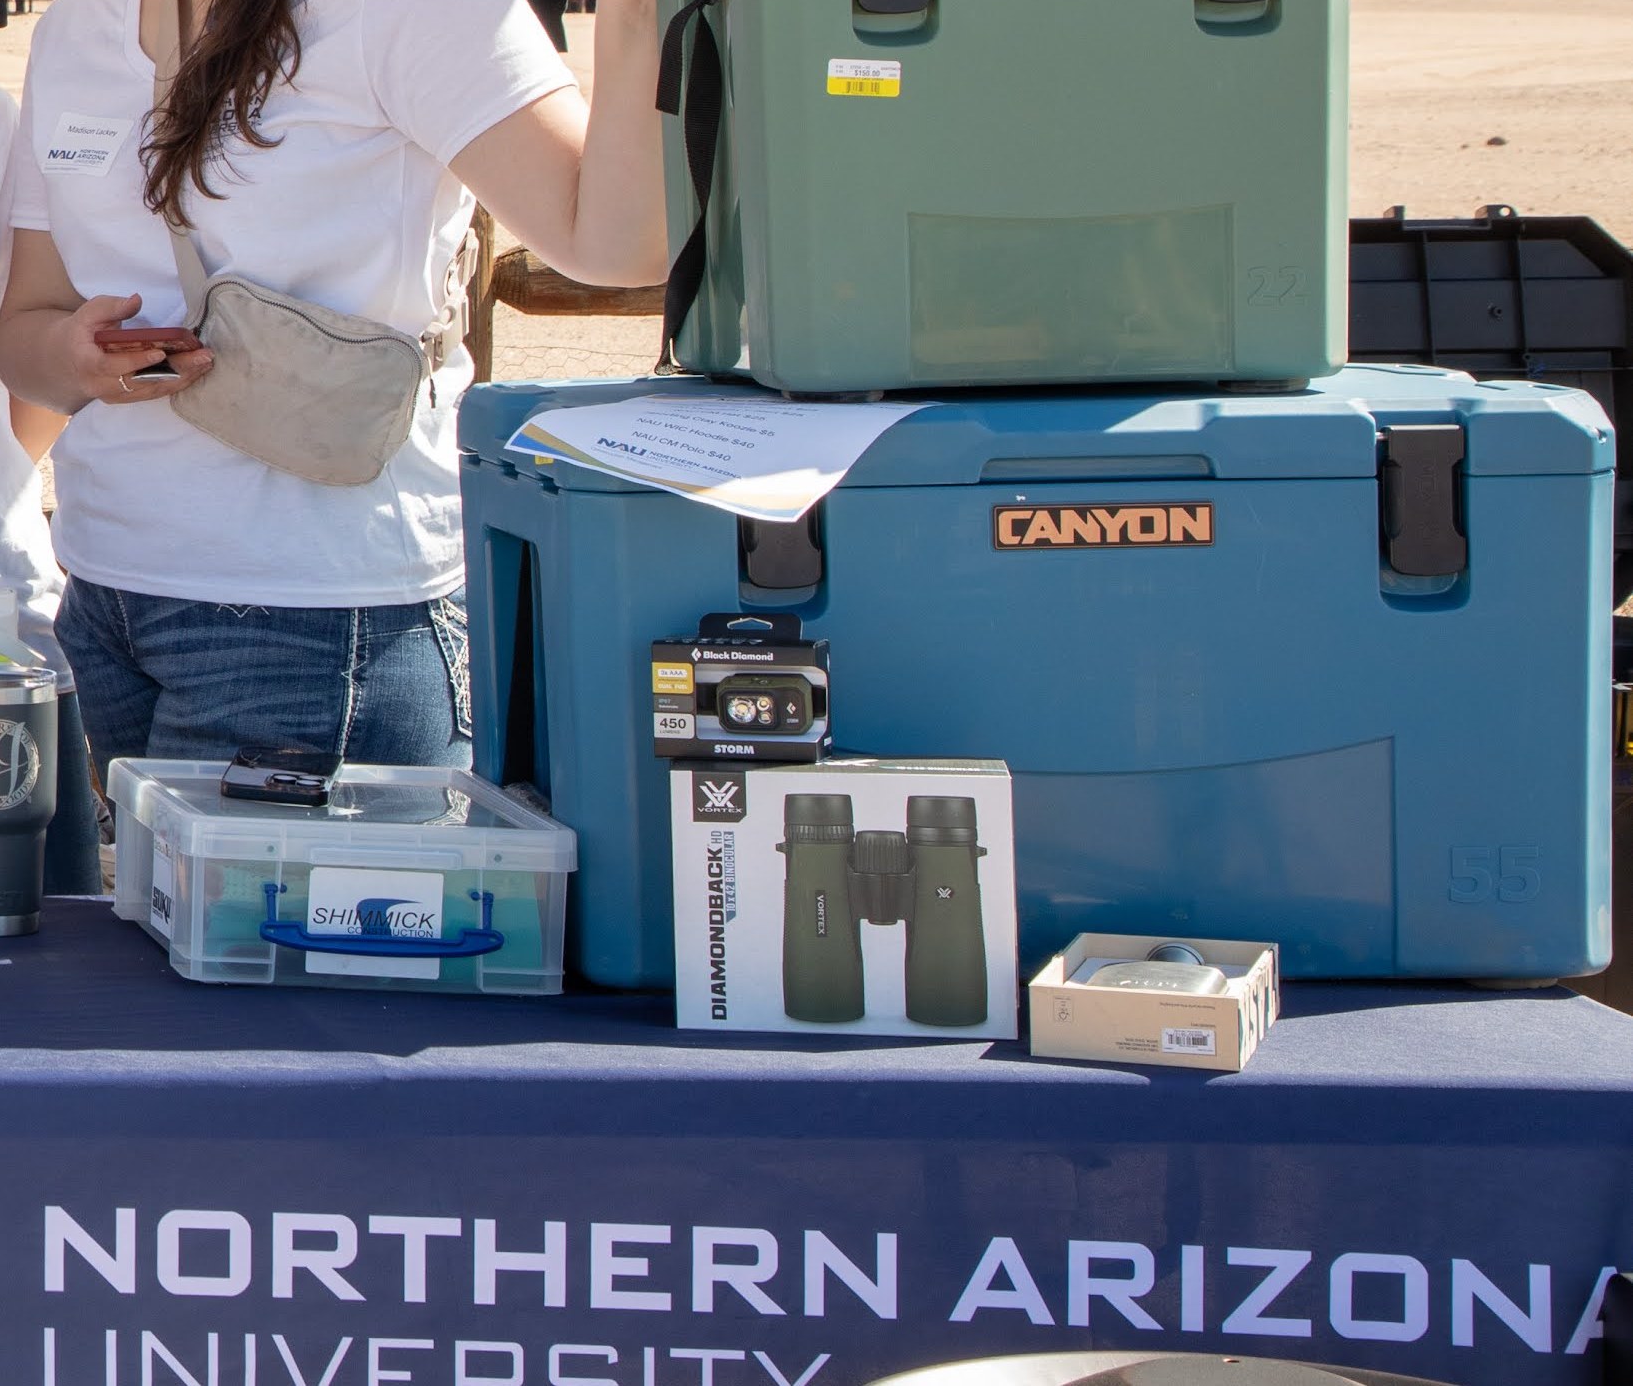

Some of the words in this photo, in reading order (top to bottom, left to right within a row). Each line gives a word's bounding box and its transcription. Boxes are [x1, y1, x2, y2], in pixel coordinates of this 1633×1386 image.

[48, 149, 76, 160] NAU
[1246, 265, 1308, 307] 22
[637, 418, 661, 426] NAU
[664, 423, 688, 432] WIC
[688, 428, 729, 443] Hoodie
[731, 437, 755, 449] $40
[597, 437, 647, 456] NAU
[632, 431, 657, 442] NAU
[658, 437, 680, 447] CM
[679, 444, 705, 456] Polo
[708, 450, 731, 462] $40
[649, 451, 699, 468] NORTHERN
[701, 466, 742, 480] ARIZONA
[998, 505, 1212, 545] CANYON
[703, 651, 729, 660] Black
[731, 651, 773, 661] Diamond
[660, 719, 686, 729] 450
[714, 745, 755, 755] STORM
[712, 830, 722, 846] HD
[725, 831, 735, 882] BINOCULAR
[1448, 845, 1542, 903] 55
[726, 883, 734, 894] 42
[313, 907, 435, 929] SHIMMICK
[726, 900, 735, 912] 10
[817, 894, 825, 935] VORTEX
[347, 925, 433, 939] CONSTRUCTION
[707, 847, 727, 1020] DIAMONDBACK
[44, 1205, 898, 1320] NORTHERN
